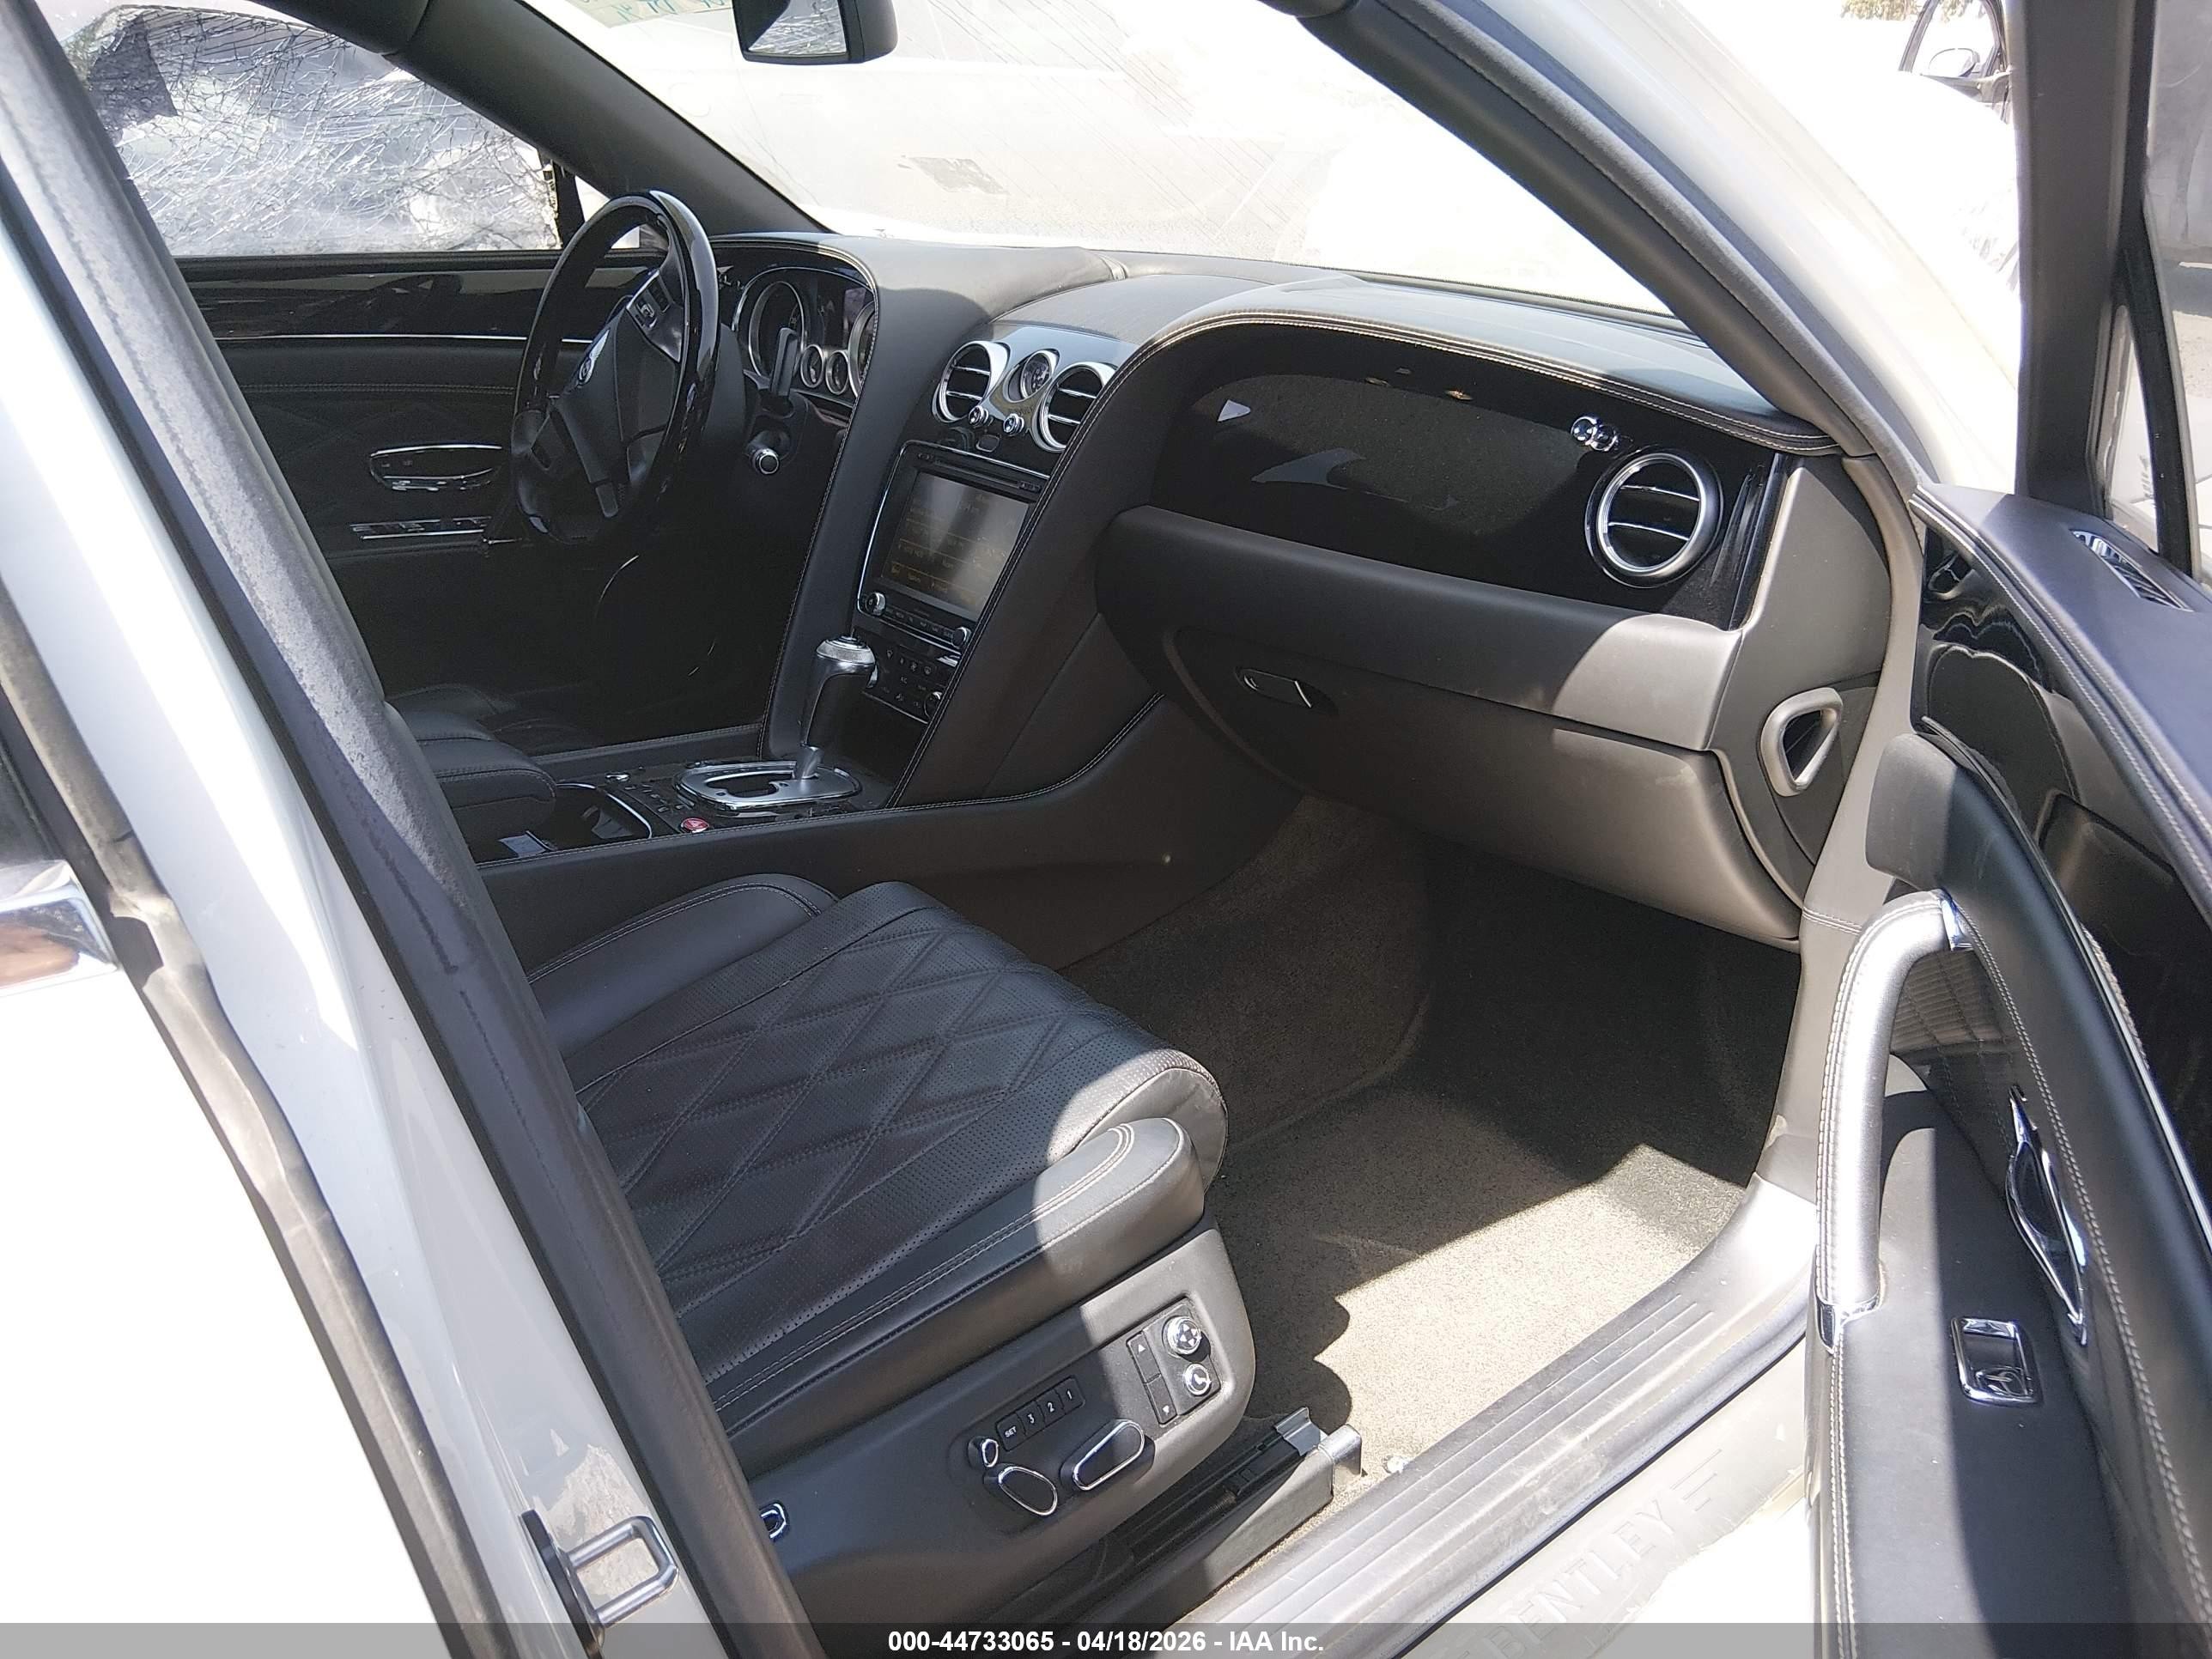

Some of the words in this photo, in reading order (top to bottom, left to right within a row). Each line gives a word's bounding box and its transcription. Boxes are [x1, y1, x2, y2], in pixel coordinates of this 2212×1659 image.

[1004, 1425, 1017, 1437] SET
[1028, 1413, 1035, 1424] 3
[1047, 1401, 1054, 1413] 2
[1066, 1389, 1073, 1400] 1
[1482, 1498, 1675, 1659] BENTLEY
